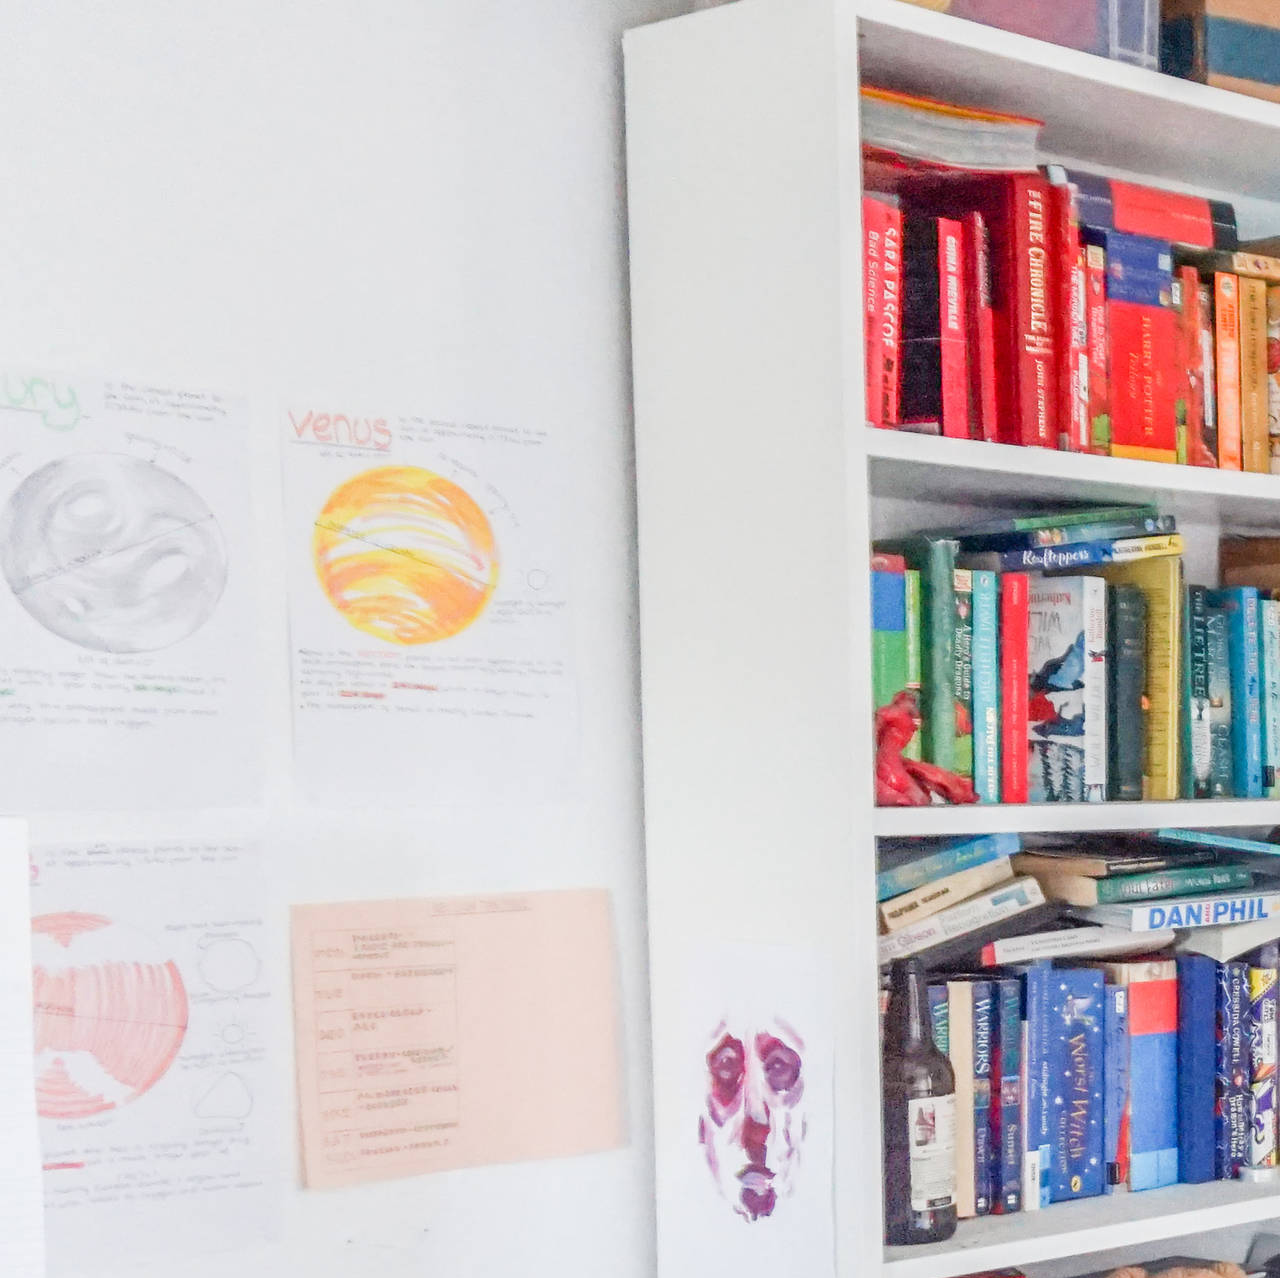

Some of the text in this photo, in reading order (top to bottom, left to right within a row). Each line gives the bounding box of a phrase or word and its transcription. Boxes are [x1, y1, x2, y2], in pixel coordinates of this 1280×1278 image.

[867, 231, 880, 255] Bad
[1027, 200, 1044, 243] FIRE
[884, 227, 897, 272] SARA
[866, 260, 878, 312] Science
[1028, 247, 1049, 332] CHRONICLE
[1071, 283, 1080, 325] MURDER
[1033, 360, 1045, 387] JOHN
[1141, 316, 1153, 436] HARRY POTTER
[288, 410, 392, 450] Venus
[1036, 389, 1047, 438] STEPHENS
[963, 635, 971, 660] Hero's
[1193, 615, 1206, 645] LIE
[954, 628, 963, 697] Deadly Dragons
[963, 664, 971, 688] Guide
[979, 637, 993, 702] MICHELLE
[1194, 646, 1208, 698] TREE
[1148, 903, 1203, 930] DAN
[1212, 897, 1269, 923] PHIL
[897, 927, 937, 948] Gibson
[1231, 977, 1241, 1026] CRESSIDA
[1231, 1027, 1241, 1064] COWELL
[975, 998, 991, 1163] WARRIORS Dawn
[1067, 1033, 1089, 1160] Worst Witch
[1007, 1123, 1018, 1165] Sunset
